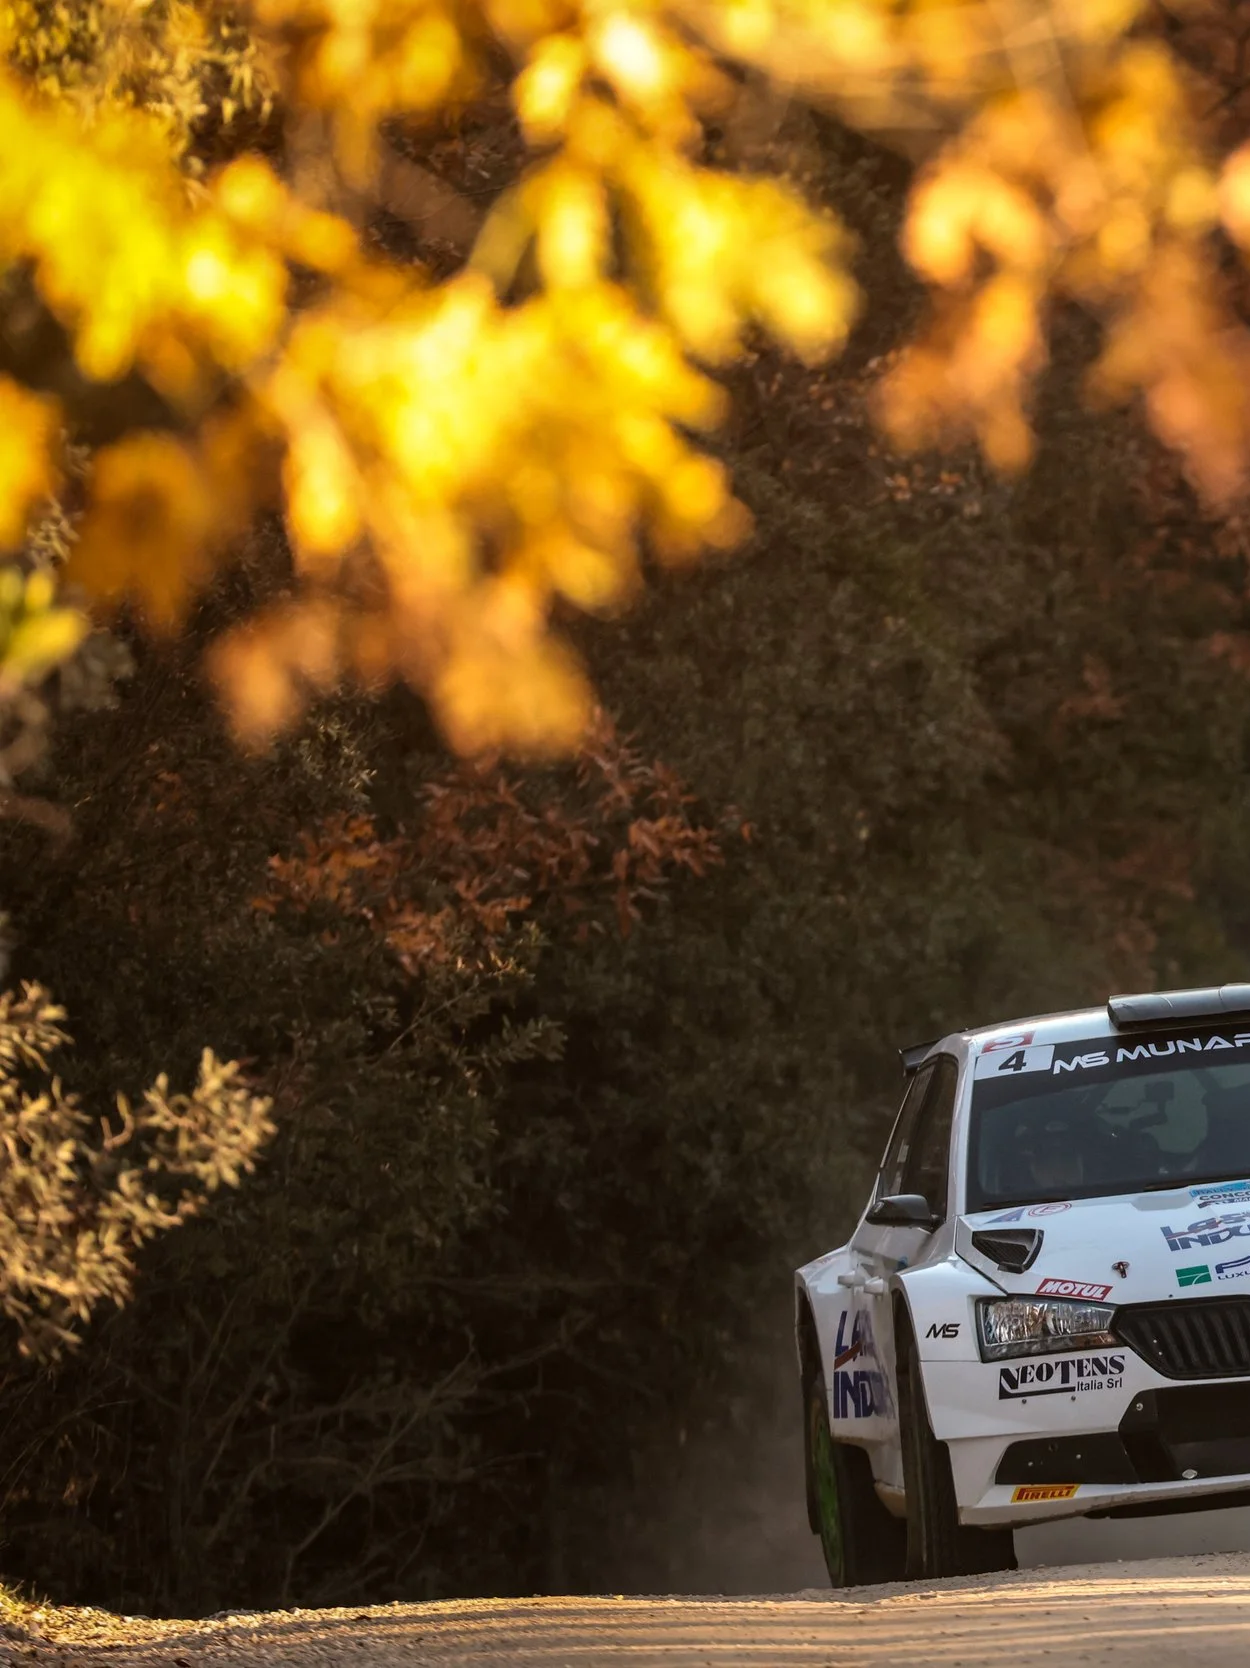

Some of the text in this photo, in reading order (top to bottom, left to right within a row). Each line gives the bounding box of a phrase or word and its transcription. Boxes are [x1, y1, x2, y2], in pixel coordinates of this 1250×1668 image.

[998, 1050, 1027, 1072] 4
[1053, 1051, 1110, 1075] MS
[1044, 1280, 1107, 1298] MOTUL
[926, 1323, 960, 1339] MS
[999, 1354, 1126, 1391] NEOTENS
[1076, 1377, 1123, 1392] Italia Srl
[1016, 1485, 1075, 1501] PIRELLI
